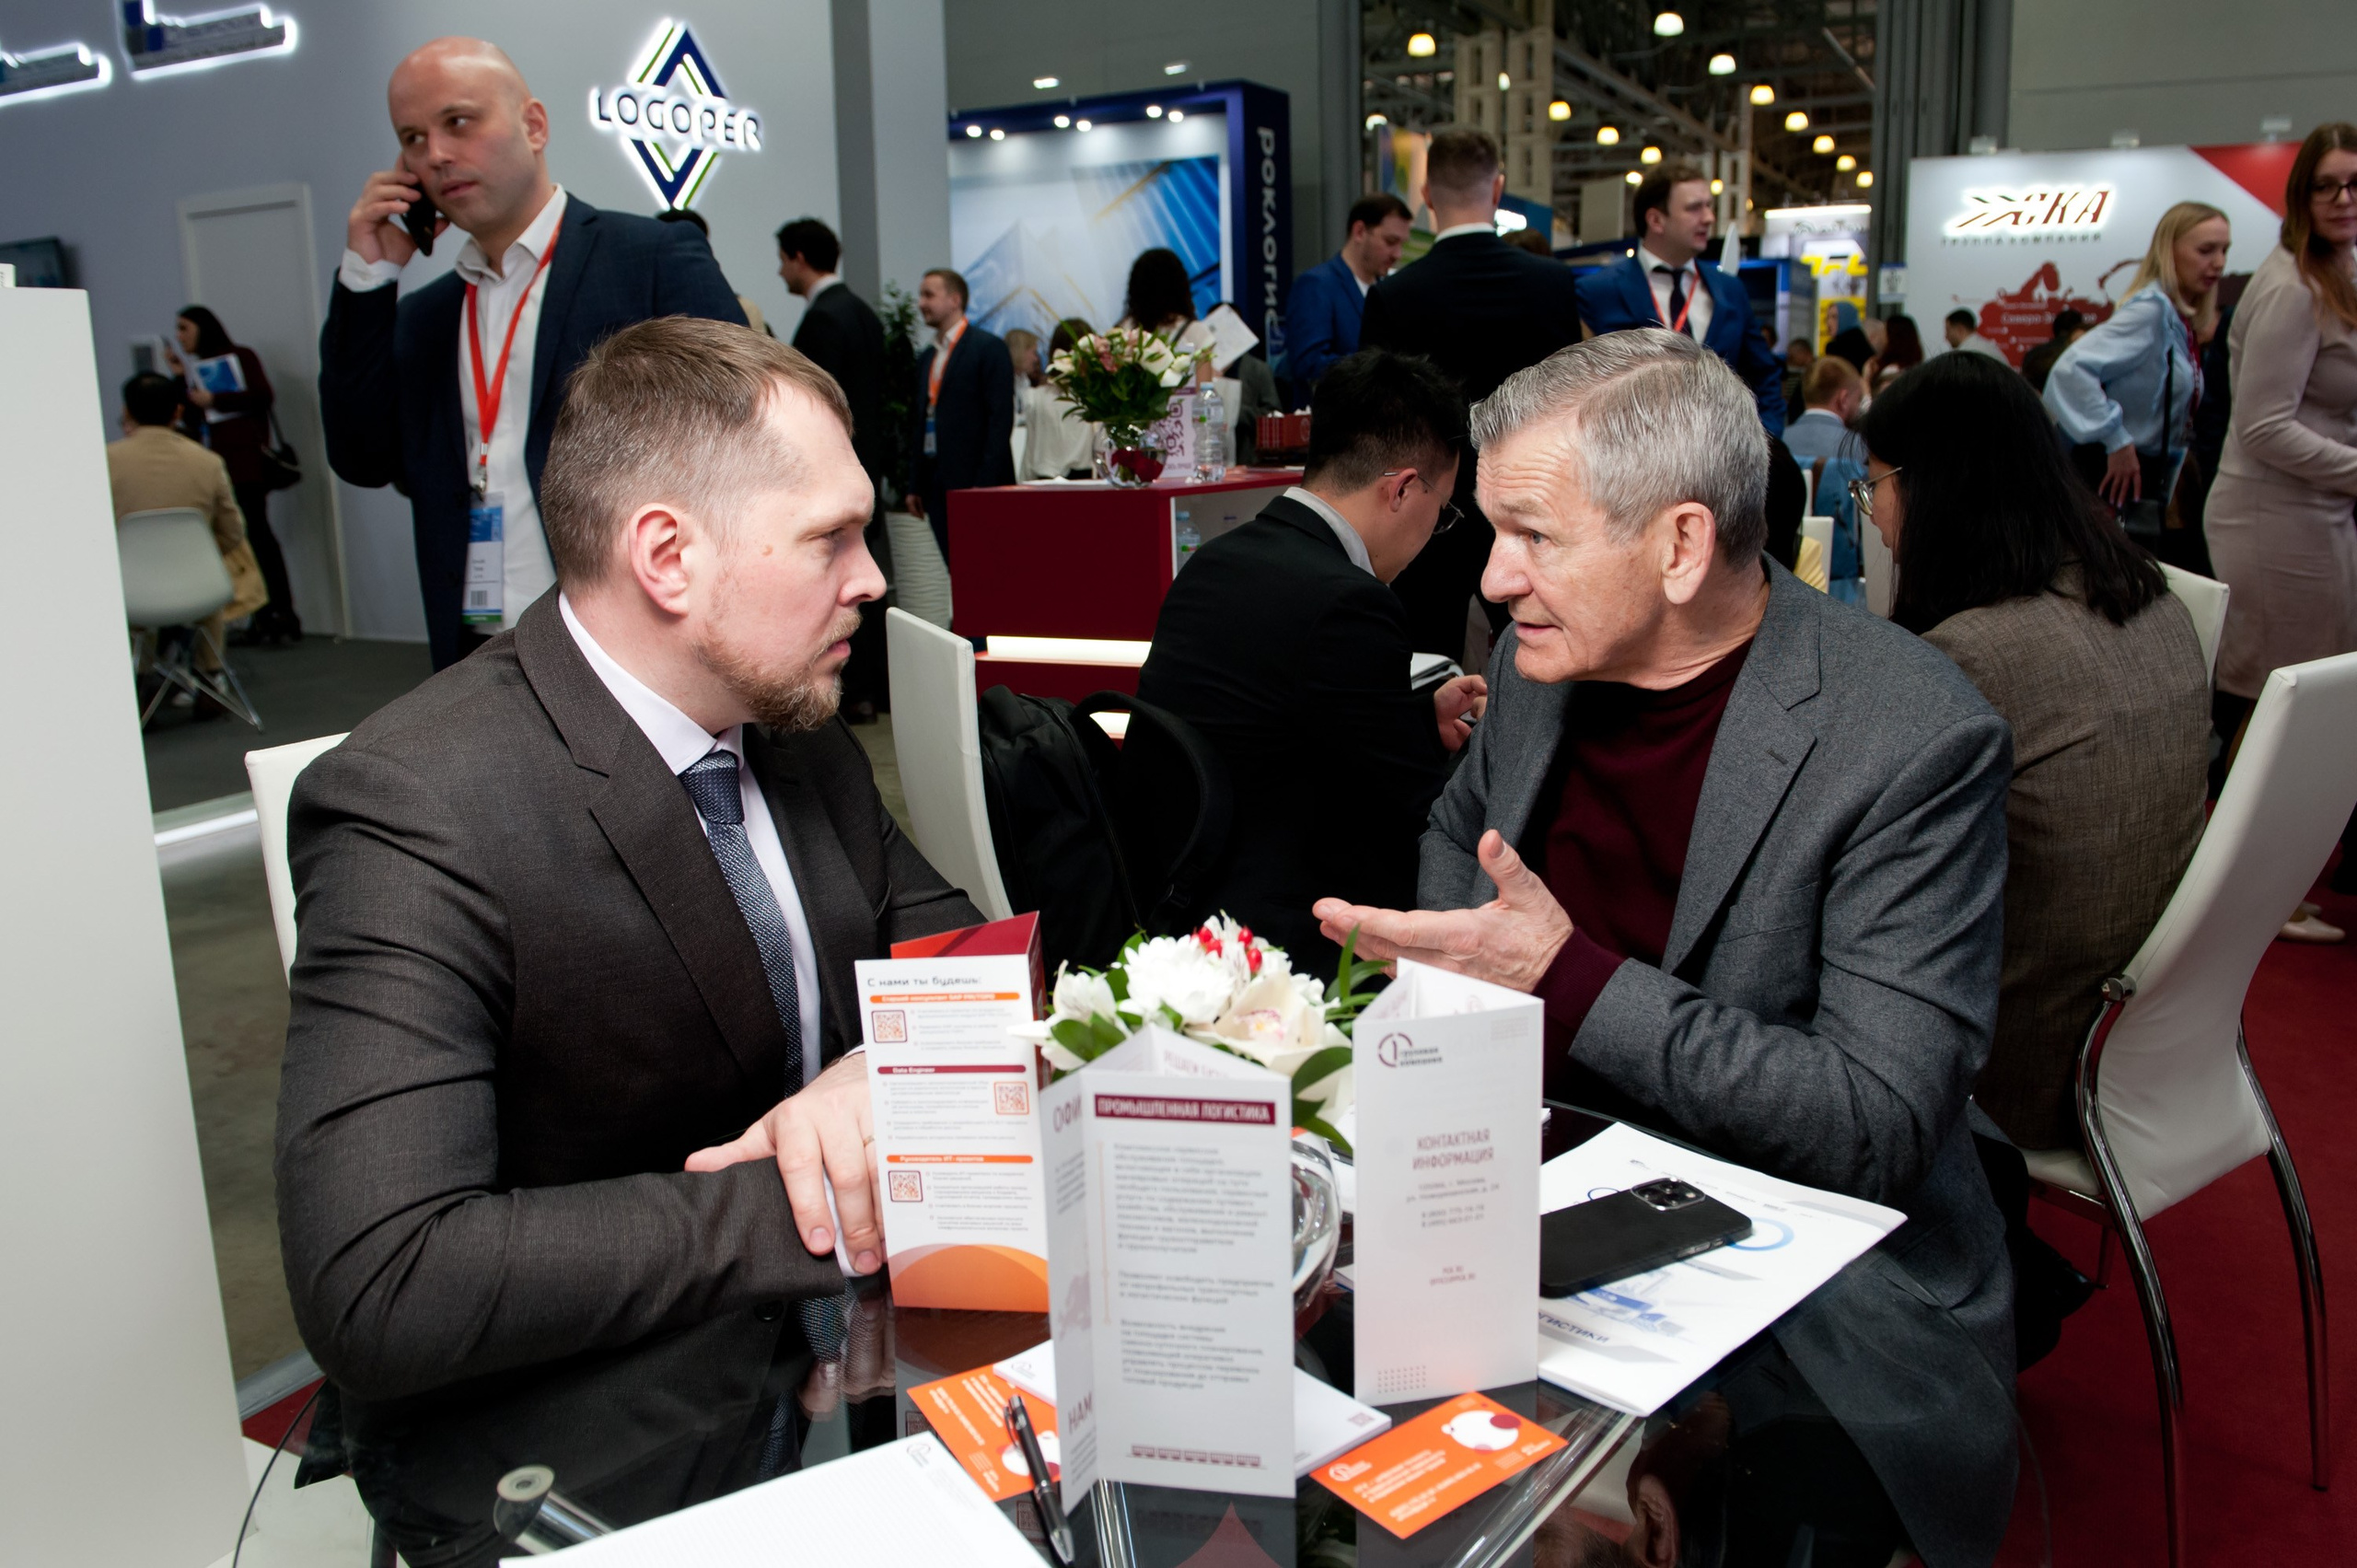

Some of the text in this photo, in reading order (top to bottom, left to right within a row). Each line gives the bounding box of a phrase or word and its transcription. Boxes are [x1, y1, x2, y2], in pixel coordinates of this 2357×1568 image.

[589, 88, 763, 151] LOGOPER
[867, 977, 876, 987] С
[878, 978, 910, 987] нами
[913, 977, 929, 986] ты
[1097, 1097, 1271, 1122] ПРОМЫШЛЕННАЯ ЛОГИСТИКА
[1416, 1128, 1491, 1151] КОНТАКТНАЯ
[1411, 1146, 1495, 1170] ИНФОРМАЦИЯ
